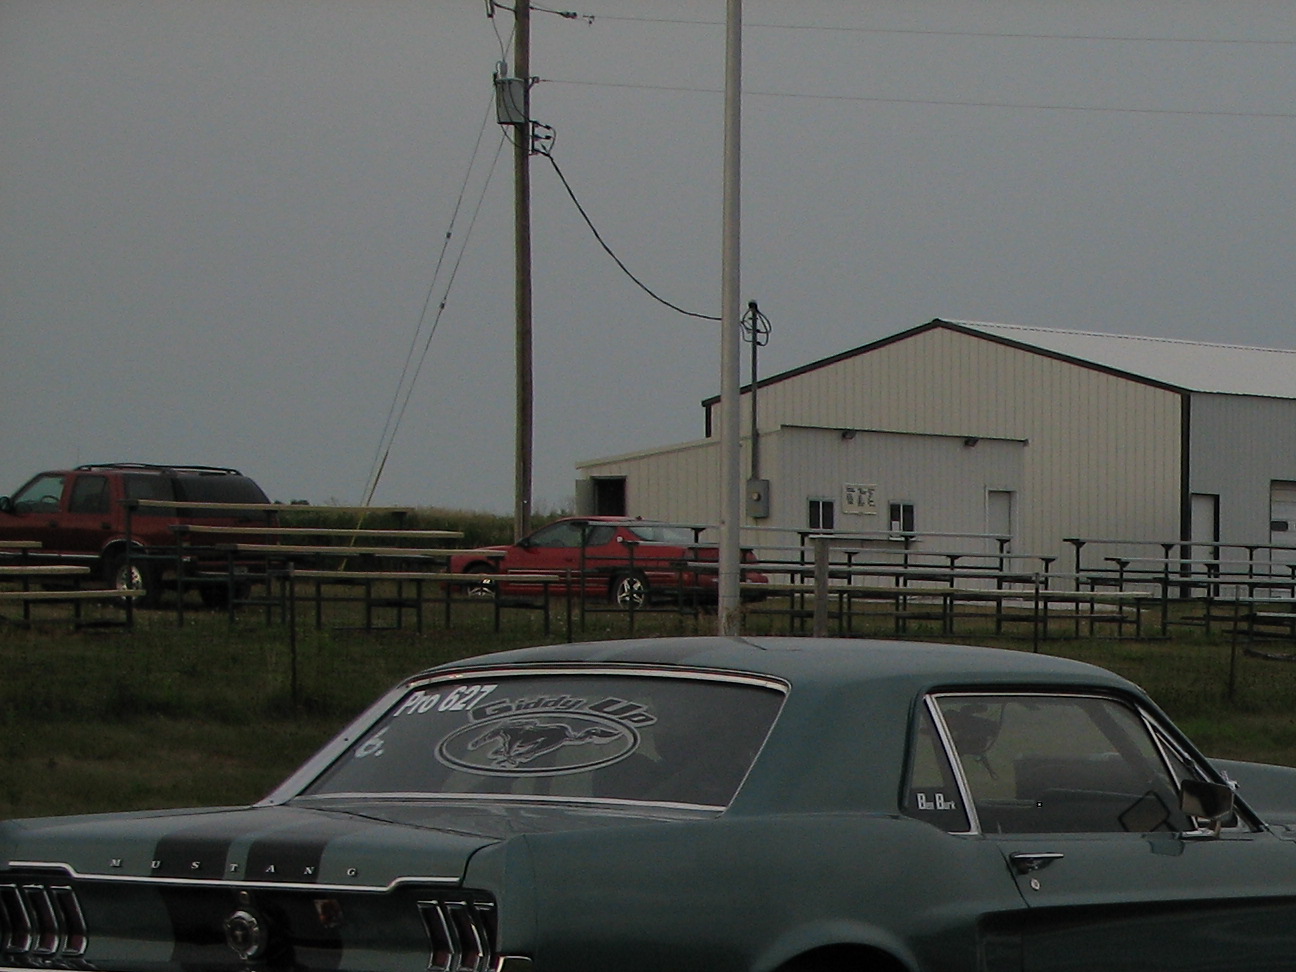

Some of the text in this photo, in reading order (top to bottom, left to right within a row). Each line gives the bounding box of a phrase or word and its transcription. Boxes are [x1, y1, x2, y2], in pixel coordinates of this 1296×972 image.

[393, 684, 498, 717] Pro 627
[469, 695, 657, 728] Giddy Up
[109, 858, 358, 877] MUSTANG
